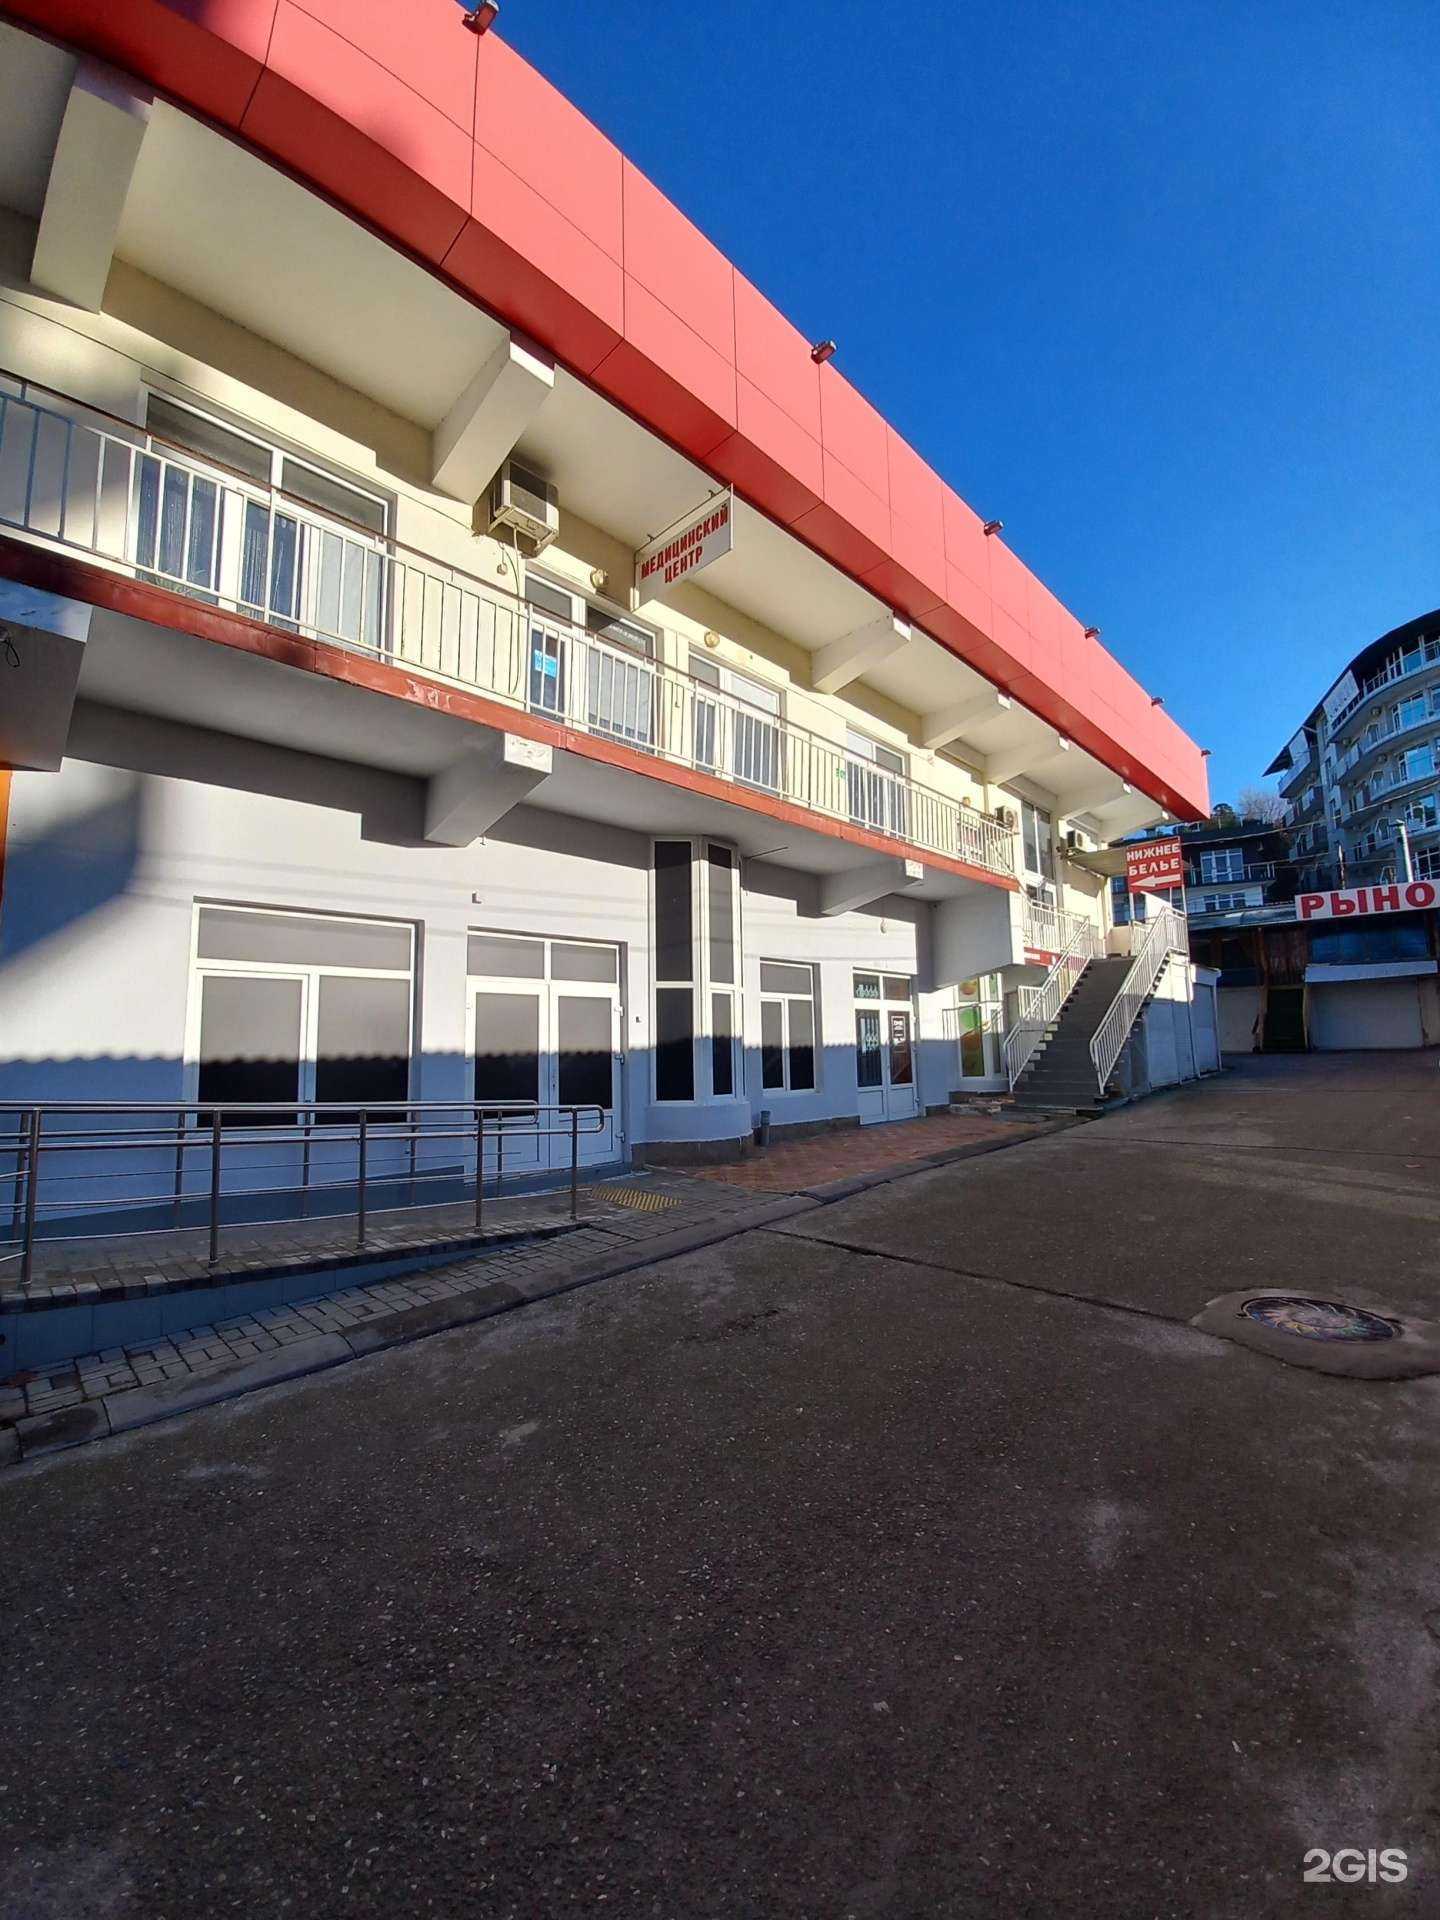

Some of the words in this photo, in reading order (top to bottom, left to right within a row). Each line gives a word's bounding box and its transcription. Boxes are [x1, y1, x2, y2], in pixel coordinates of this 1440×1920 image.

[641, 503, 729, 580] МЕДИЦИНСКИЙ
[664, 546, 703, 583] ЦЕНТР
[1126, 843, 1180, 861] НИЖНЕЕ
[1129, 858, 1180, 876] БЕЛЬЕ
